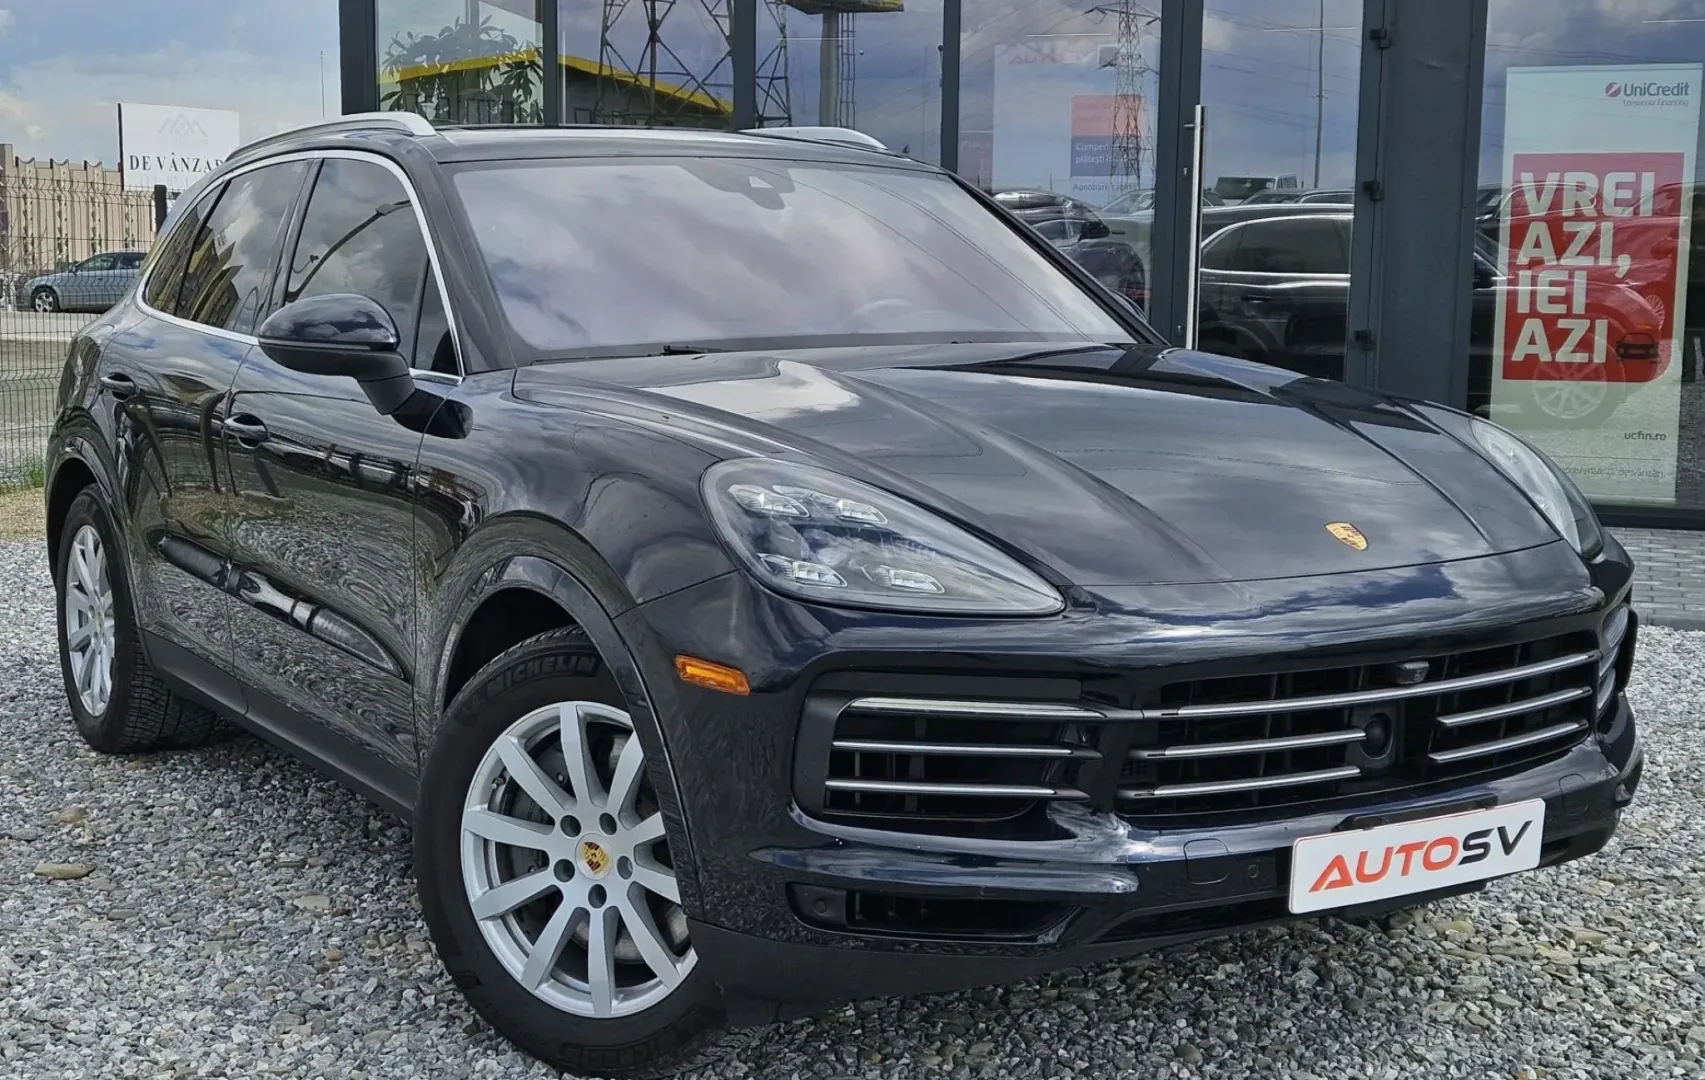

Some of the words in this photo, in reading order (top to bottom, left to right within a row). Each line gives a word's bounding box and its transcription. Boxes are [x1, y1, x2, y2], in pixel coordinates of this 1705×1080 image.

[1623, 82, 1690, 97] UniCredit
[129, 155, 152, 171] DE
[1520, 171, 1656, 217] VREI
[1516, 221, 1632, 278] AZI,
[1516, 270, 1588, 314] IEI
[1511, 318, 1609, 364] AZI
[1624, 431, 1667, 441] ucfin.ro
[486, 655, 597, 699] MICHELIN
[1308, 819, 1534, 893] AUTOSV
